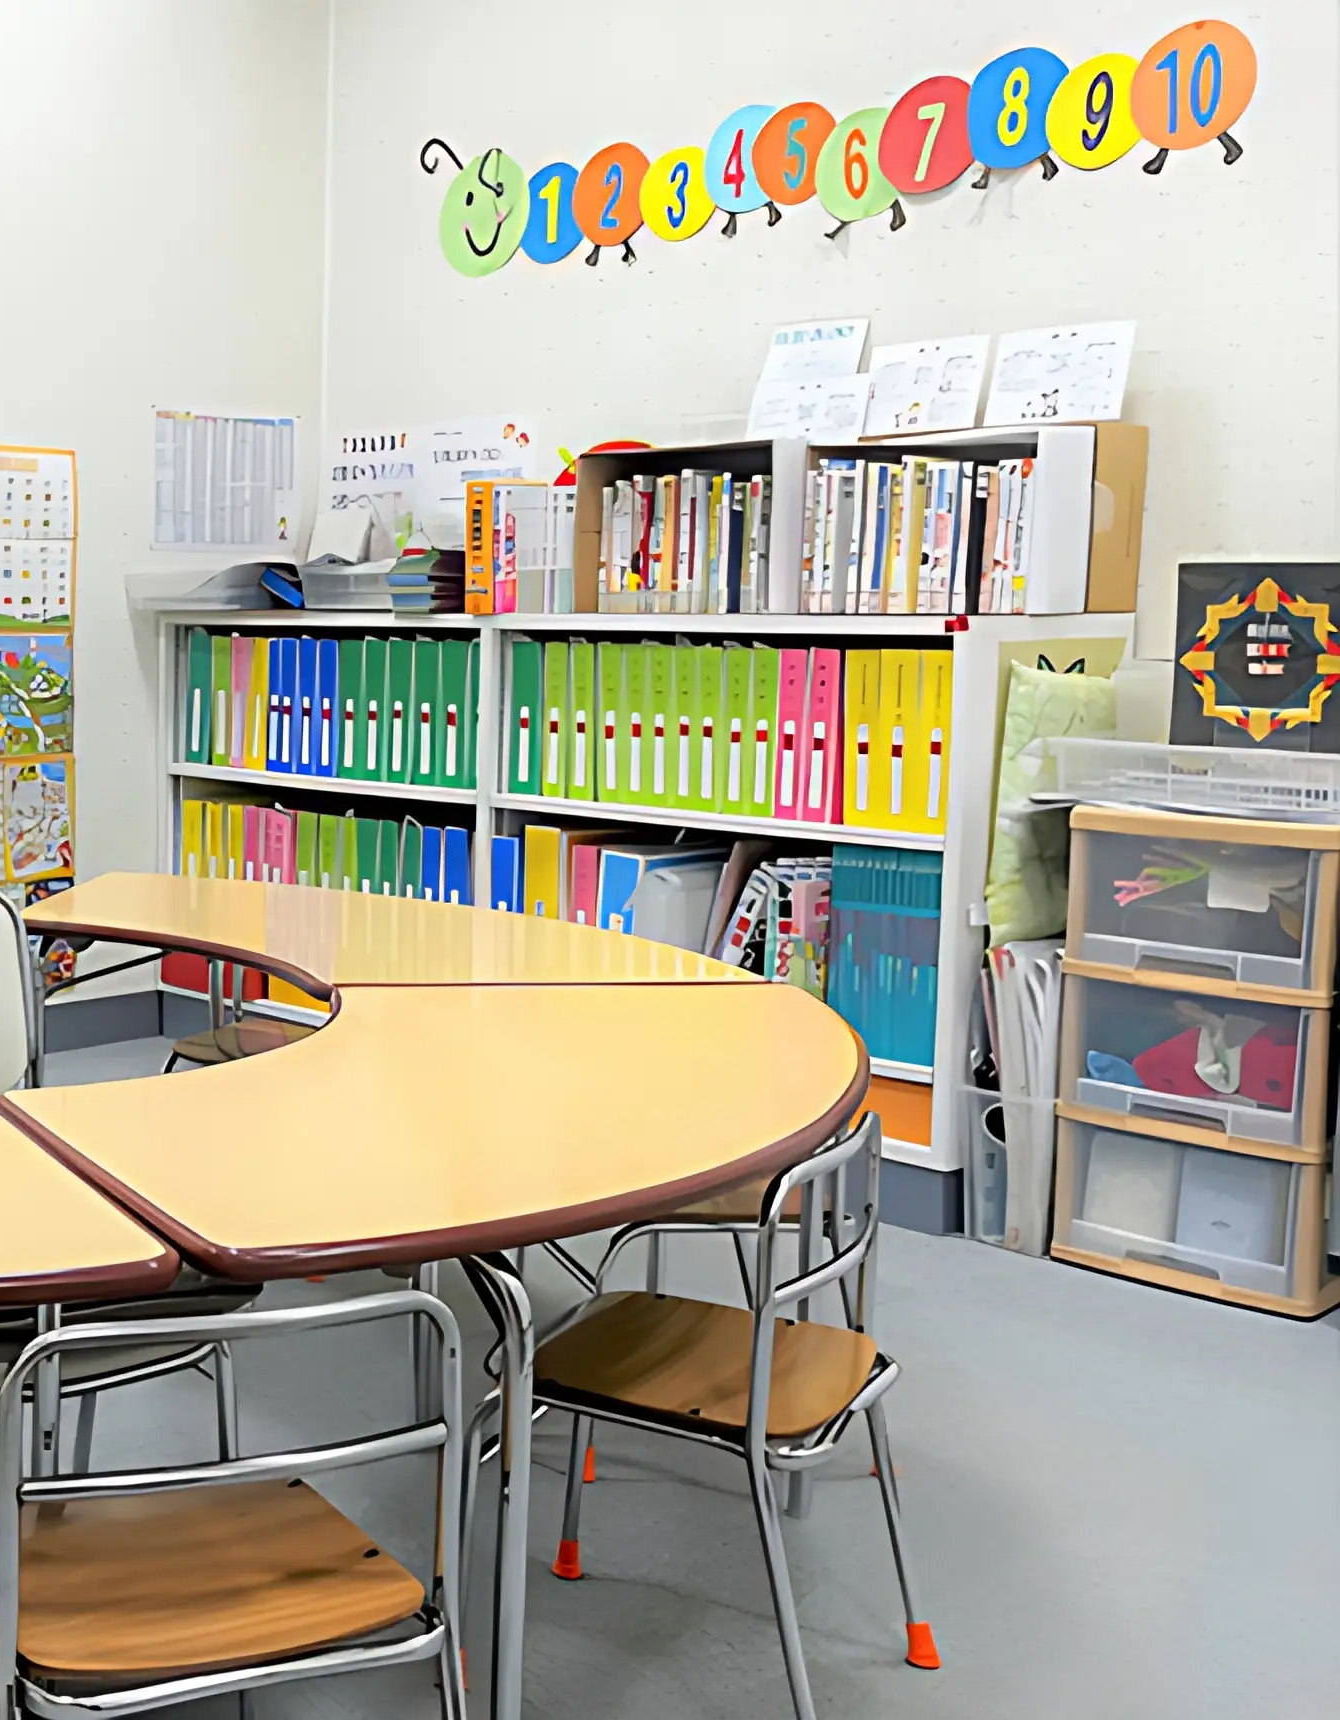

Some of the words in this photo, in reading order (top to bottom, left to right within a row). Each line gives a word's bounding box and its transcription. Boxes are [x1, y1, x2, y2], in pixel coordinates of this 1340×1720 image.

[539, 176, 561, 244] 1
[600, 162, 624, 229] 2
[667, 161, 689, 229] 3
[723, 128, 745, 198] 4
[783, 117, 807, 190] 5
[844, 127, 868, 200] 6
[914, 102, 945, 183] 7
[996, 66, 1030, 147] 8
[1080, 70, 1114, 151] 9
[1155, 42, 1223, 135] 10
